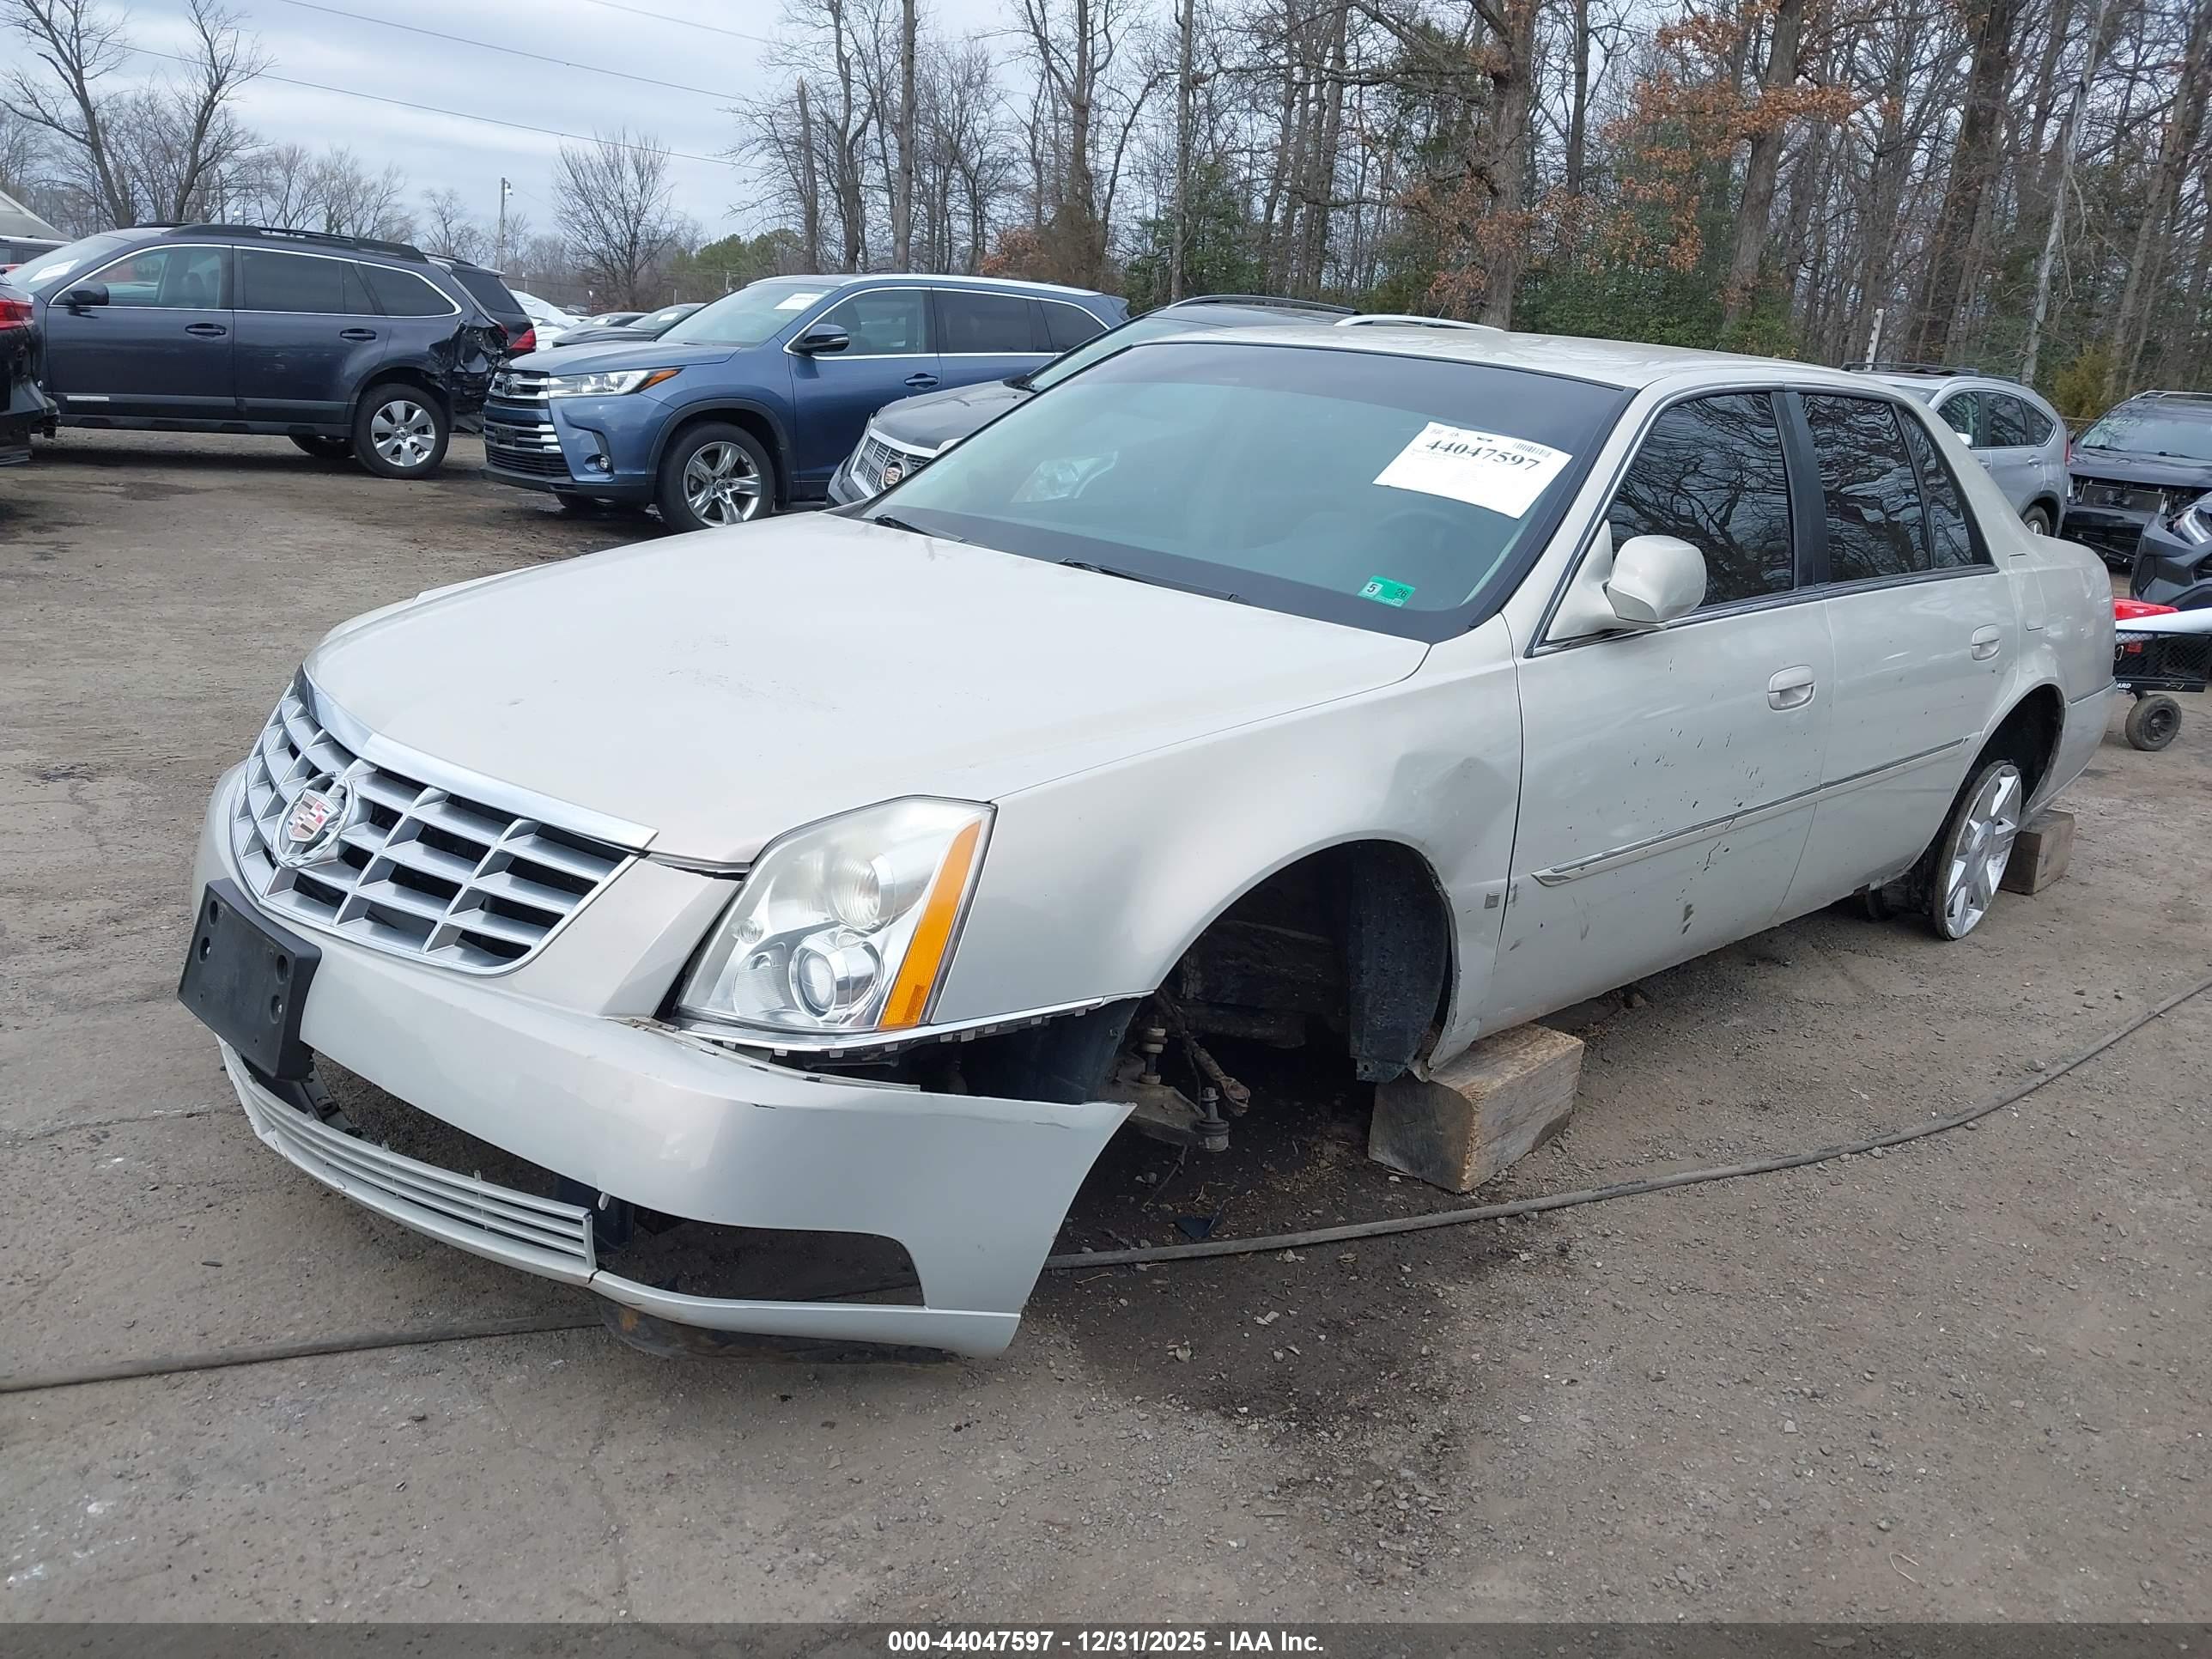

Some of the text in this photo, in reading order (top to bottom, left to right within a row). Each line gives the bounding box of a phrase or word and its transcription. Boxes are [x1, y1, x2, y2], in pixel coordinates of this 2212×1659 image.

[1425, 440, 1540, 471] 44047597
[1367, 583, 1409, 599] 5 26
